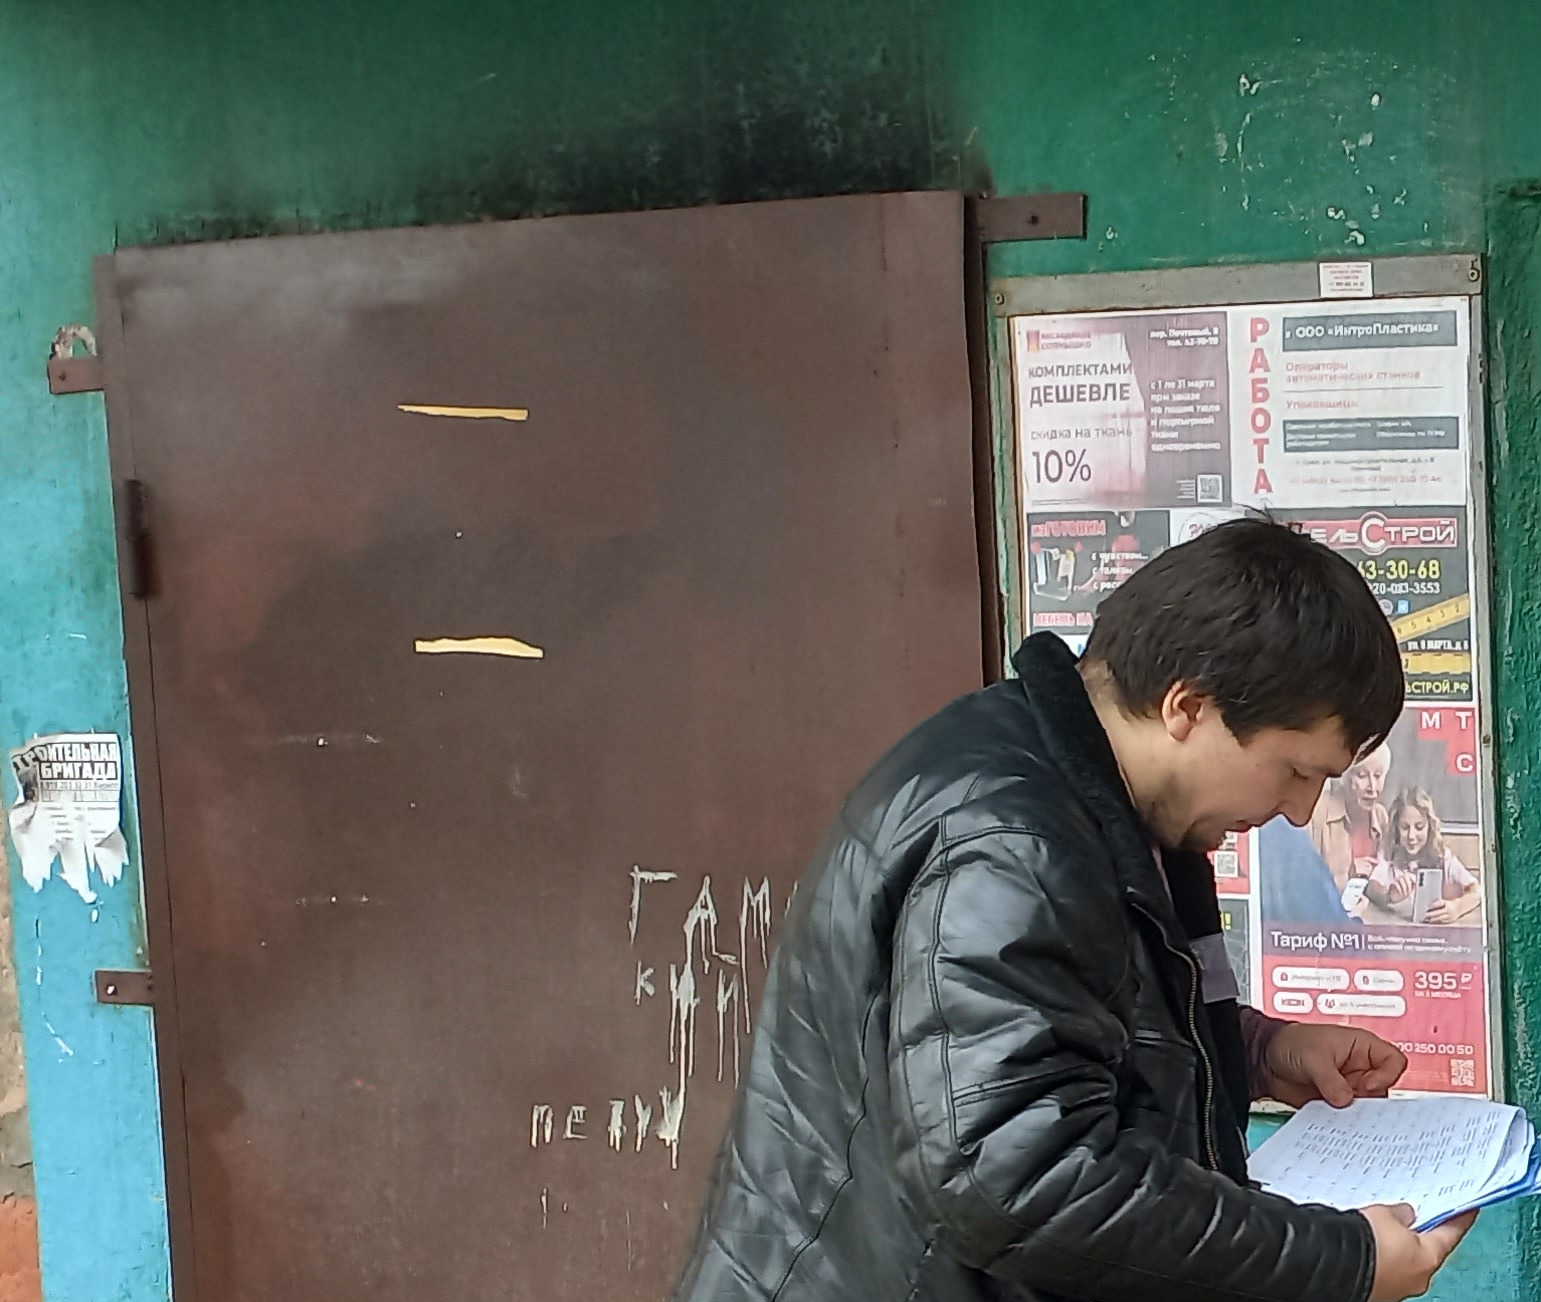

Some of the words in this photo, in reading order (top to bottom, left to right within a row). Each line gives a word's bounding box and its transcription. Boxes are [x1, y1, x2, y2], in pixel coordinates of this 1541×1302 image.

[1296, 326, 1325, 338] ООО
[1028, 363, 1134, 379] КОМПЛЕКТАМИ
[1029, 382, 1131, 409] ДЕШЕВЛЕ
[1030, 429, 1071, 441] скидка
[1074, 428, 1091, 439] на
[1094, 428, 1133, 439] ткань
[1031, 448, 1092, 484] 10%
[1303, 517, 1456, 549] ЕЛЬСТРОЙ
[1406, 679, 1470, 695] ЬСТРОЙ.РФ
[13, 742, 117, 772] ТРОИТЕЛЬНАЯ
[41, 762, 118, 780] БРИГАДА
[1270, 931, 1329, 951] Тариф
[1331, 934, 1360, 949] №1
[1414, 970, 1457, 990] 395
